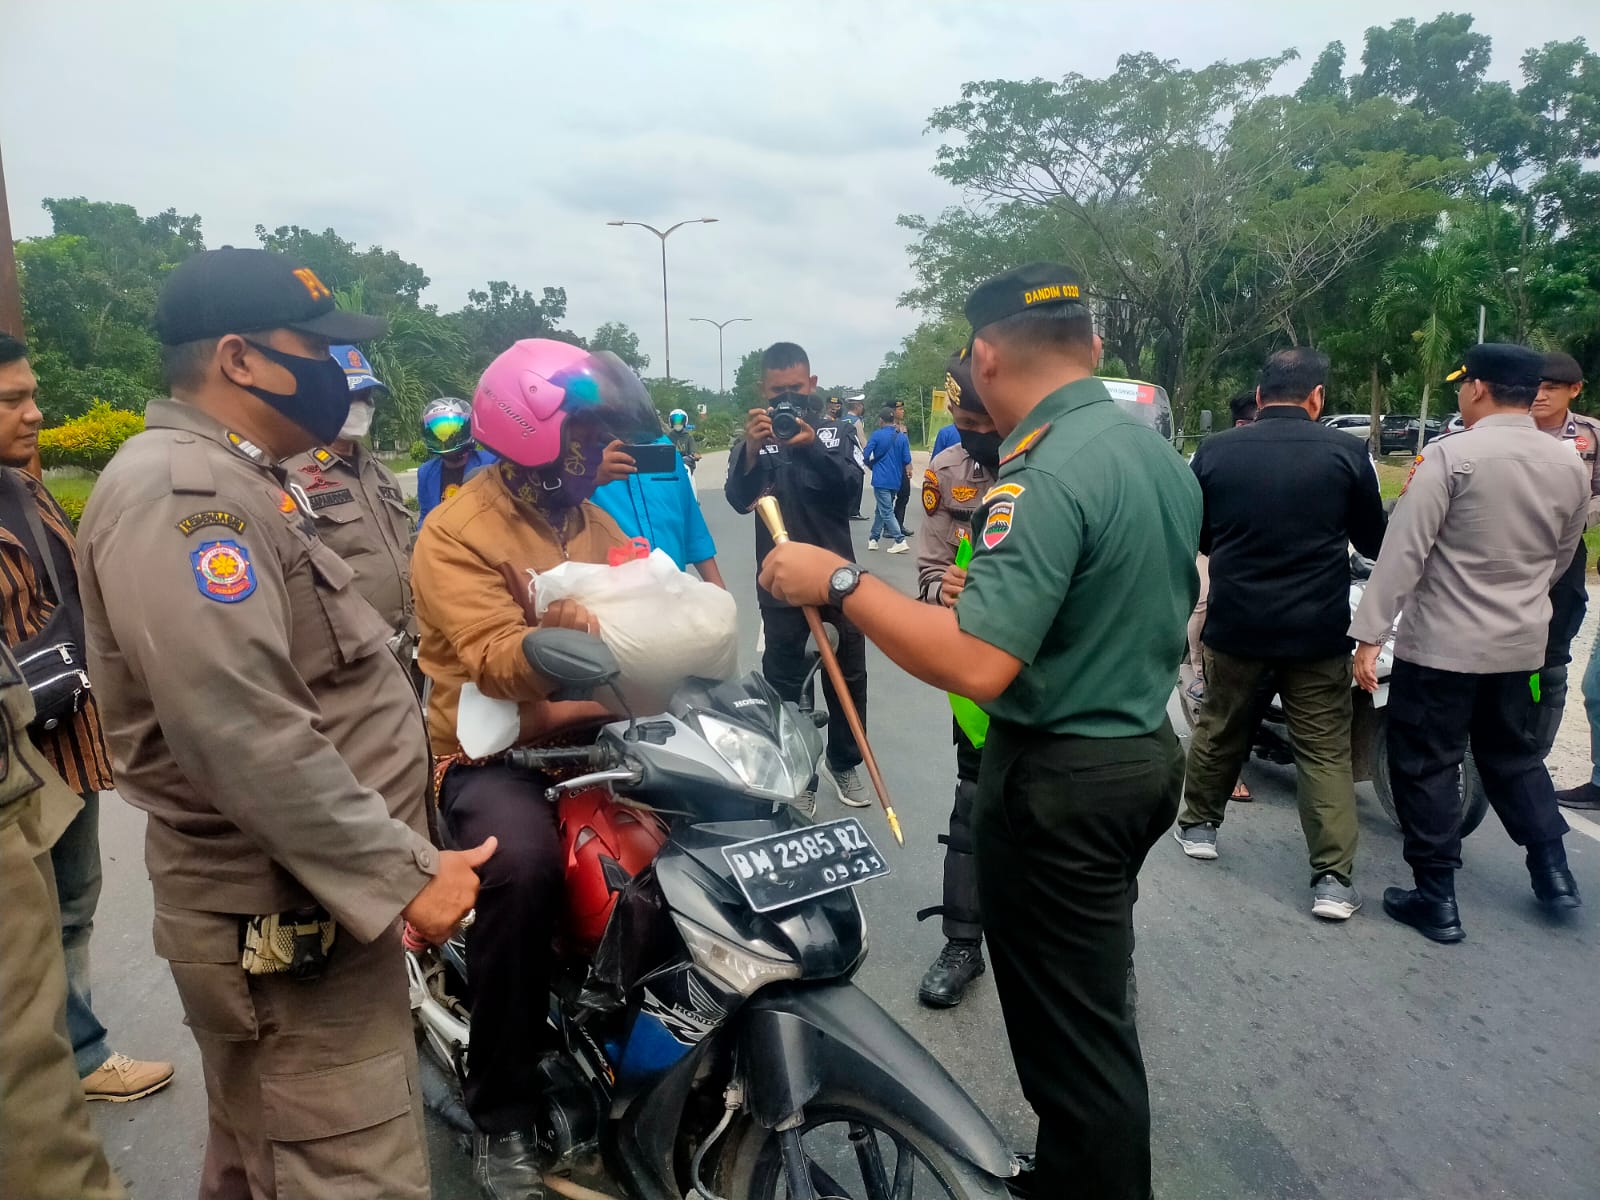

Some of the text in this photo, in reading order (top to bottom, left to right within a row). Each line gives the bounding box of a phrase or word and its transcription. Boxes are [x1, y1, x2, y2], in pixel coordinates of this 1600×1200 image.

[1025, 285, 1060, 304] DANDIM
[733, 698, 767, 708] HONDA
[732, 825, 868, 878] BM 2385 RZ
